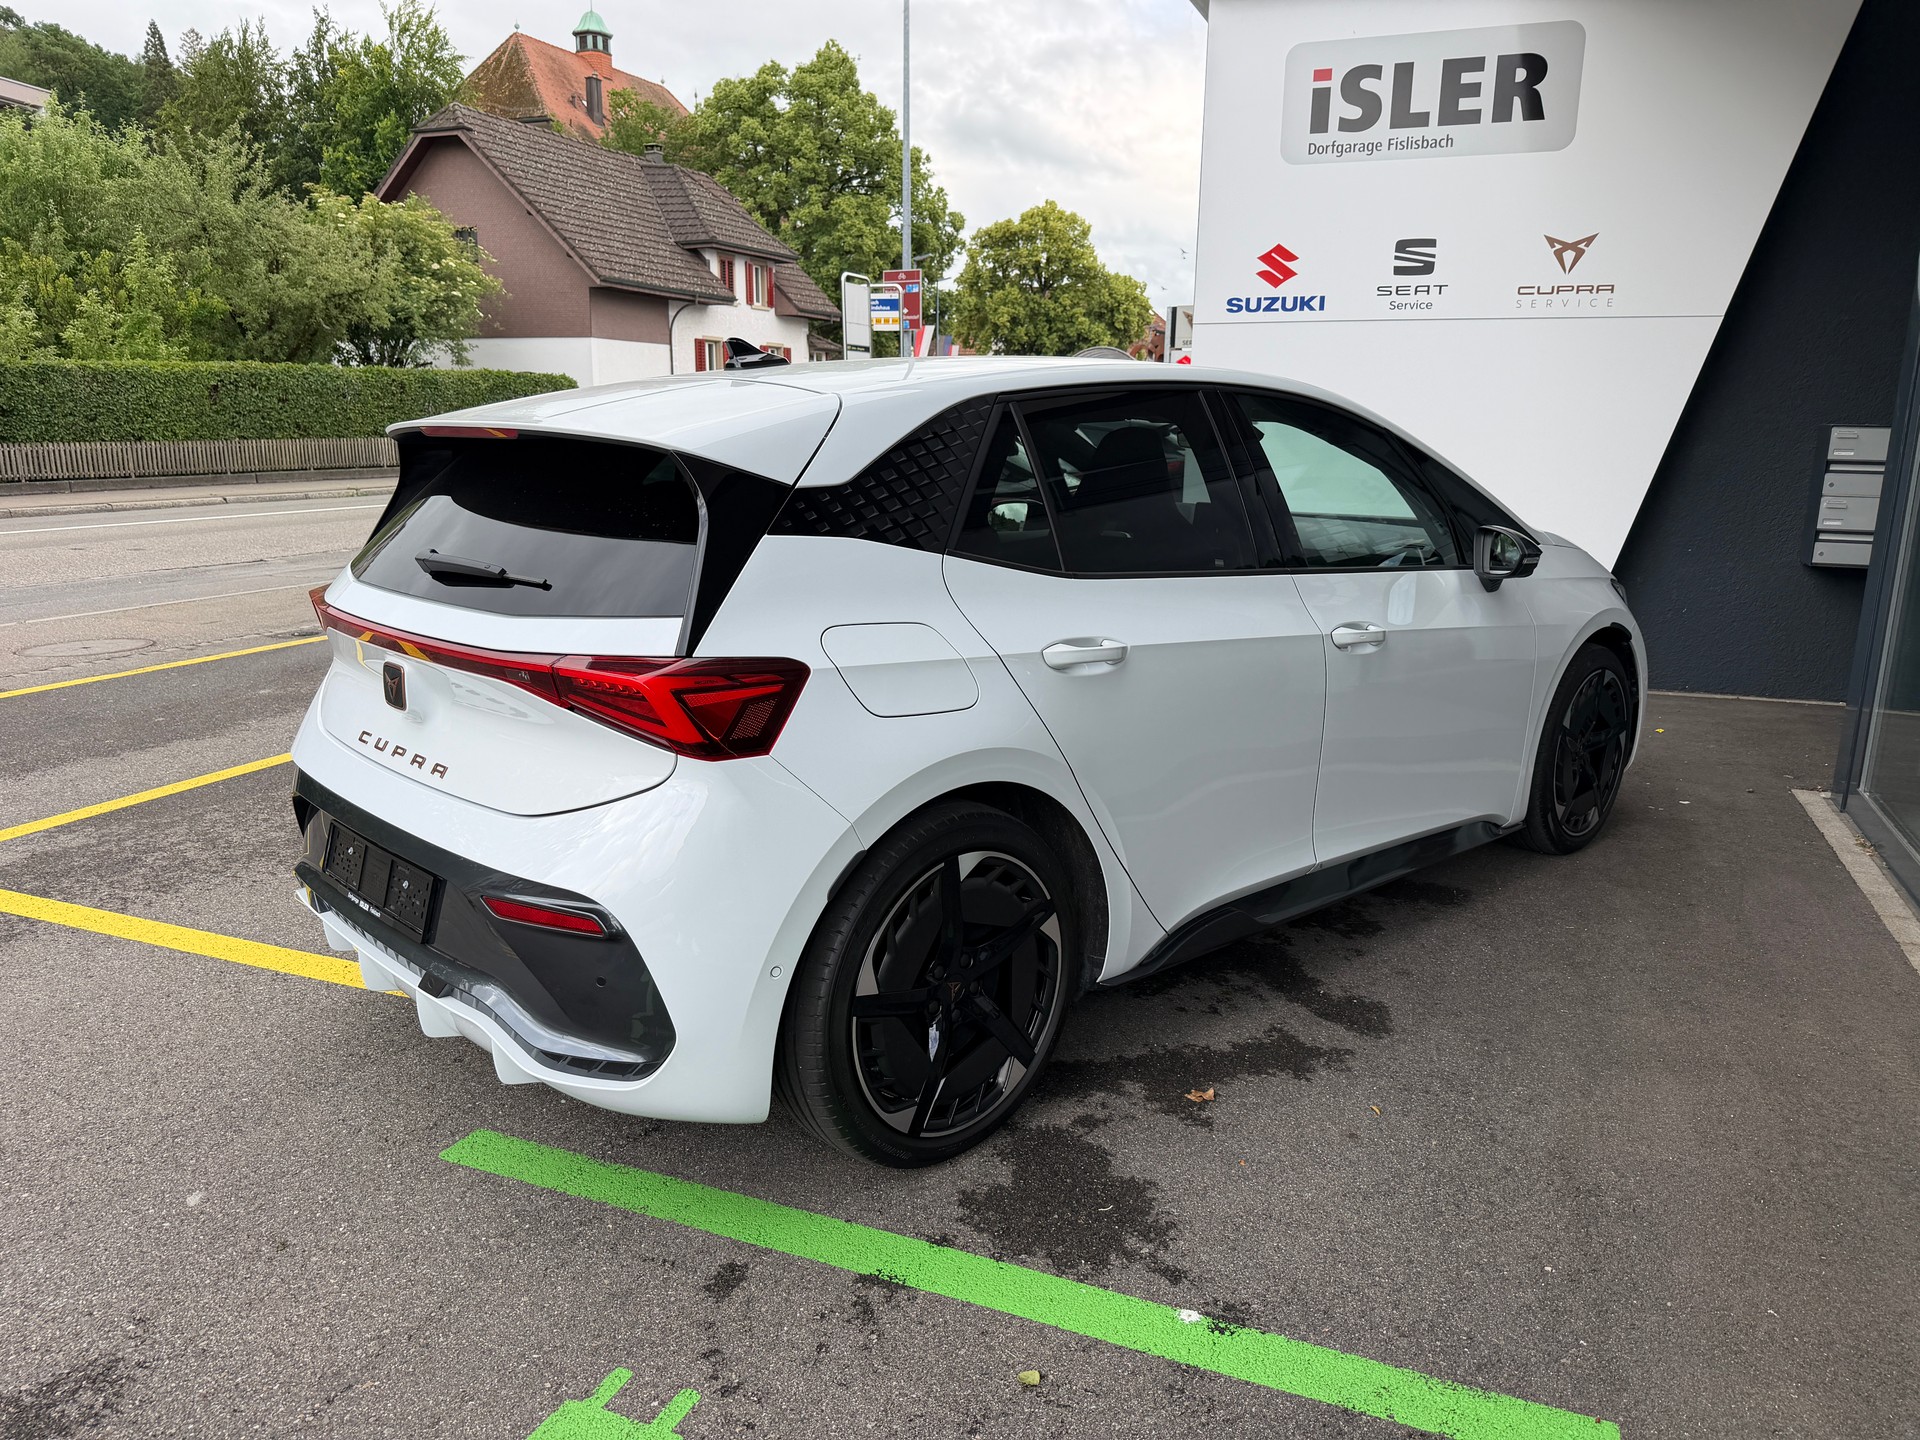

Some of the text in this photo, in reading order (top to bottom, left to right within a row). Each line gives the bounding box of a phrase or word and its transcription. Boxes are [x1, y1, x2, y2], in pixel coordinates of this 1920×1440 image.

[1308, 134, 1454, 158] Dorfgarage Fislisbach
[1376, 284, 1449, 296] SEAT
[1517, 284, 1615, 295] CUPRA
[1225, 295, 1326, 313] SUZUKI
[1388, 299, 1433, 311] Service
[1516, 297, 1614, 309] SERVICE
[357, 730, 449, 779] CUPRA
